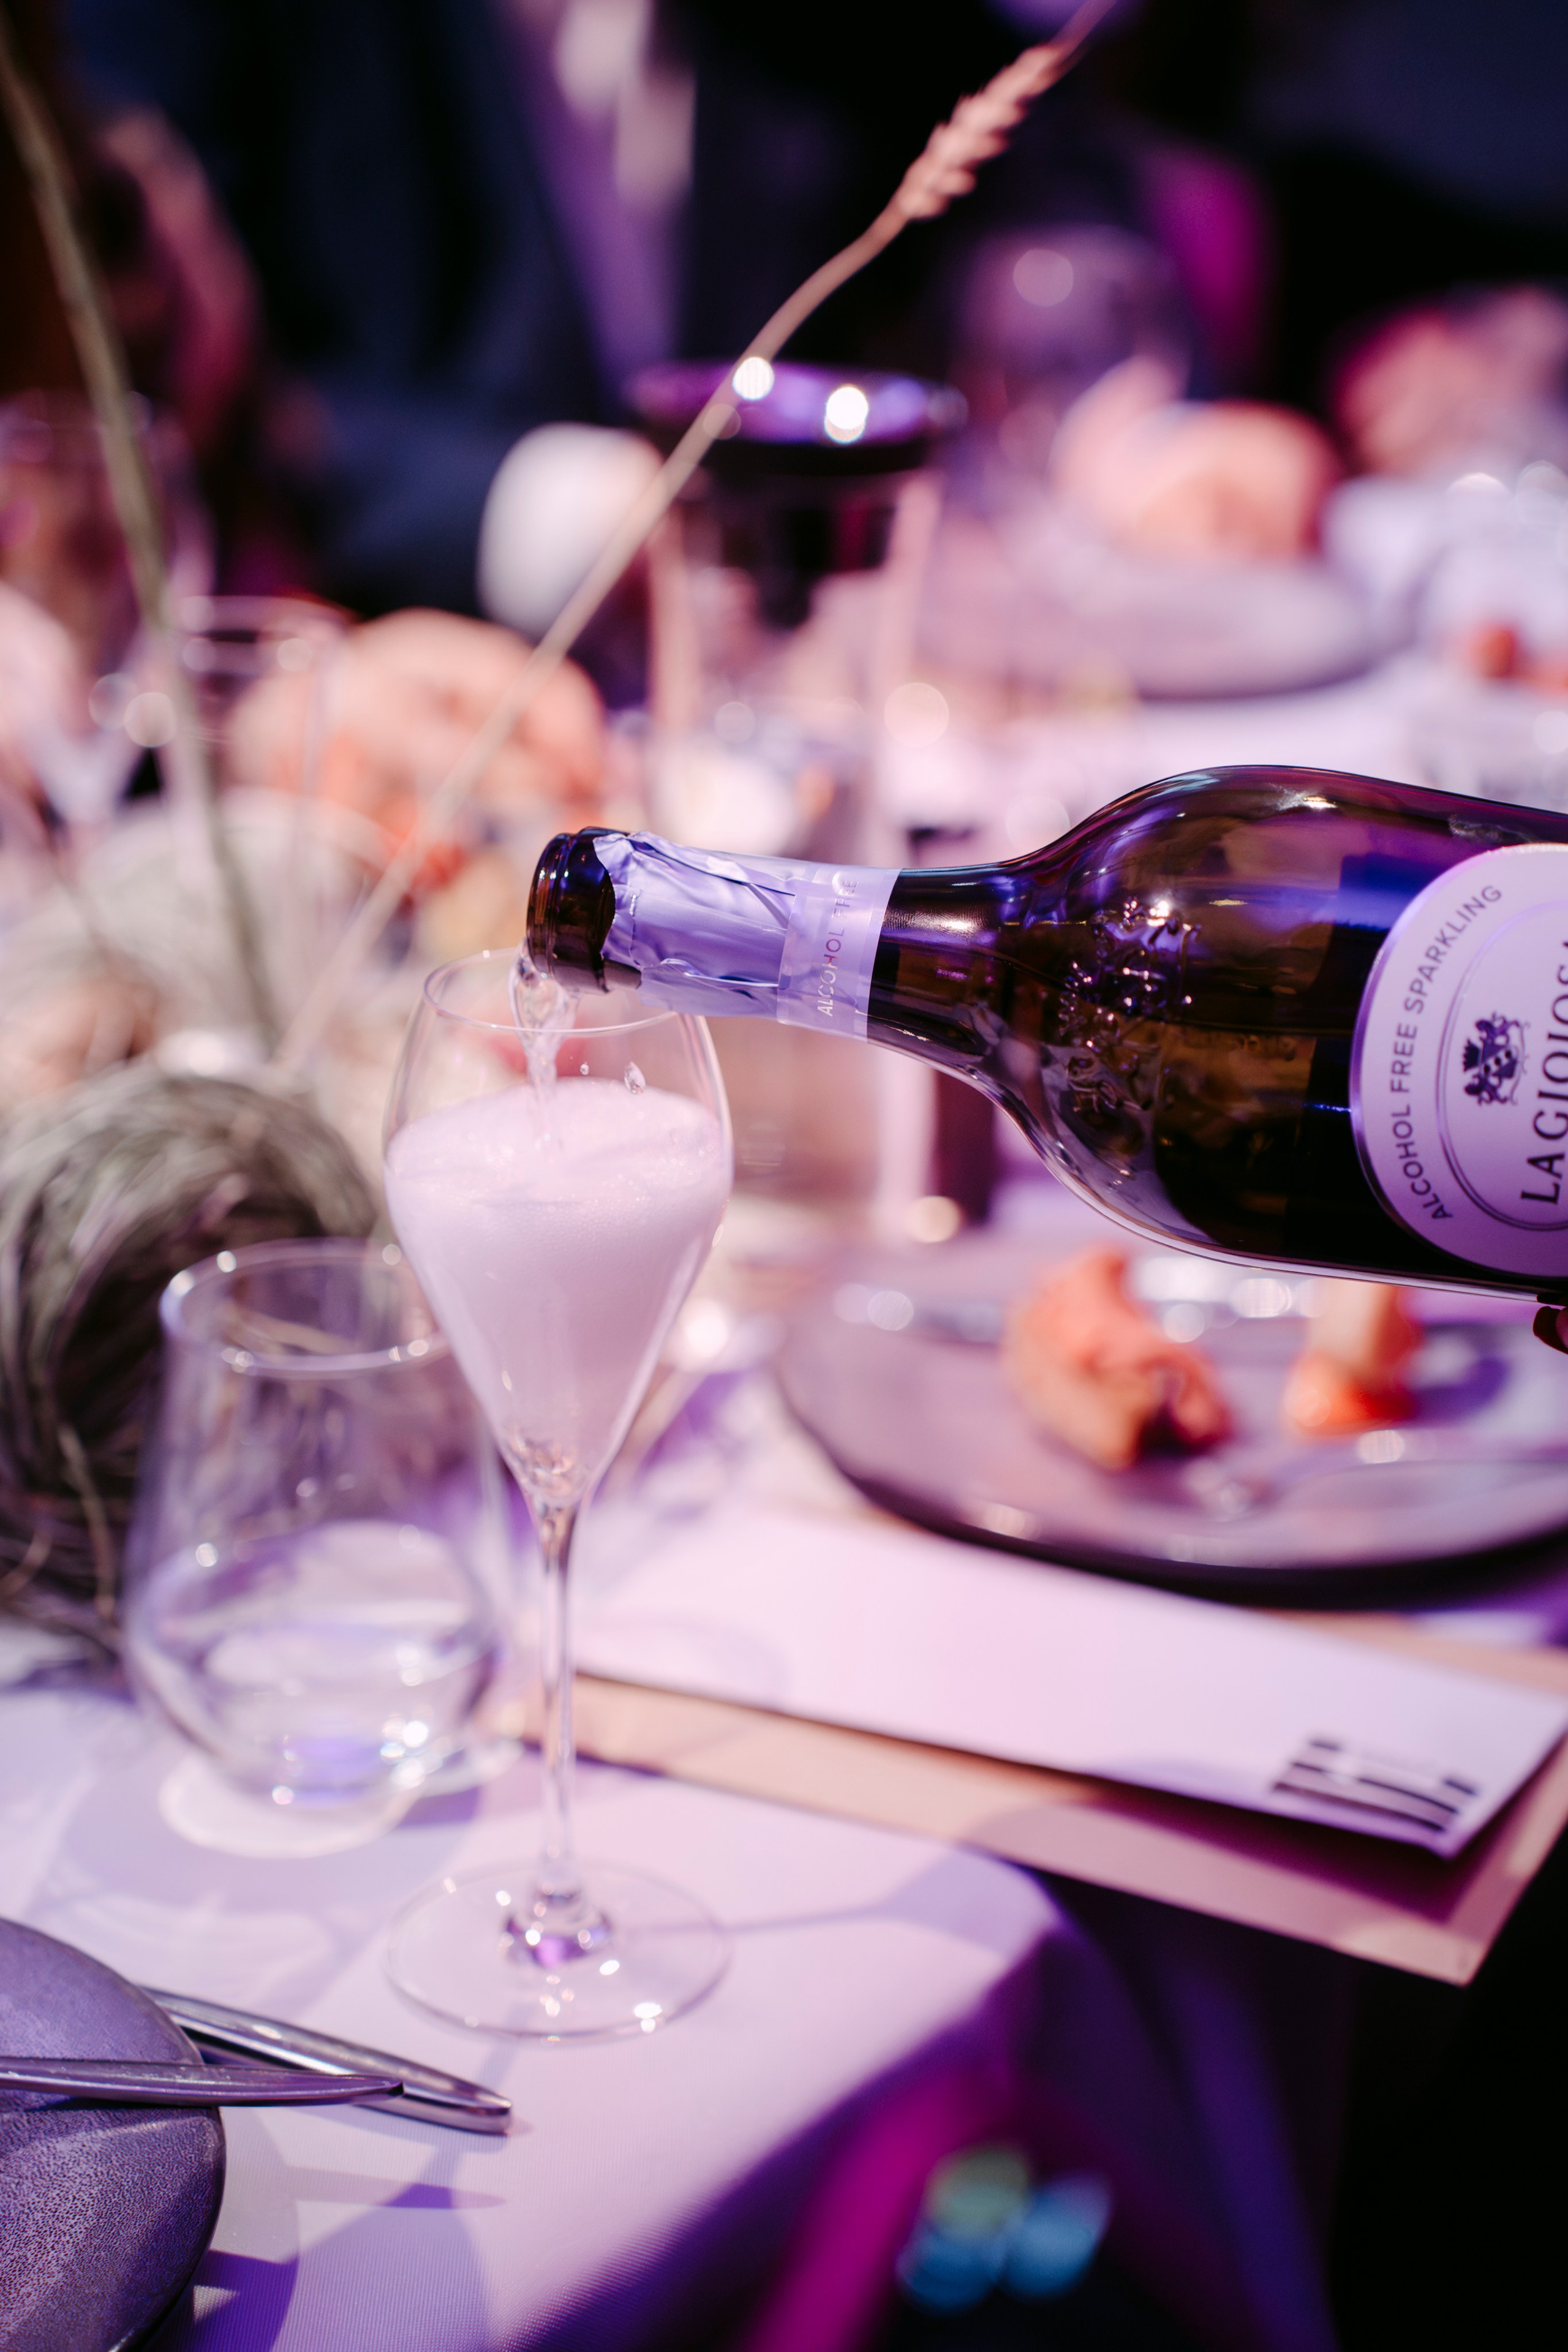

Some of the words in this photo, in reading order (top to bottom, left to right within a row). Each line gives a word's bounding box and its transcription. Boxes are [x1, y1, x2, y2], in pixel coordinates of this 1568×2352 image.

[816, 927, 845, 1017] ALCOHOL
[831, 880, 859, 919] FREE
[1403, 885, 1502, 1014] SPARKLING
[1390, 1023, 1417, 1093] FREE
[1520, 941, 1568, 1205] LAGIOI
[1390, 1104, 1453, 1219] ALCOHOL
